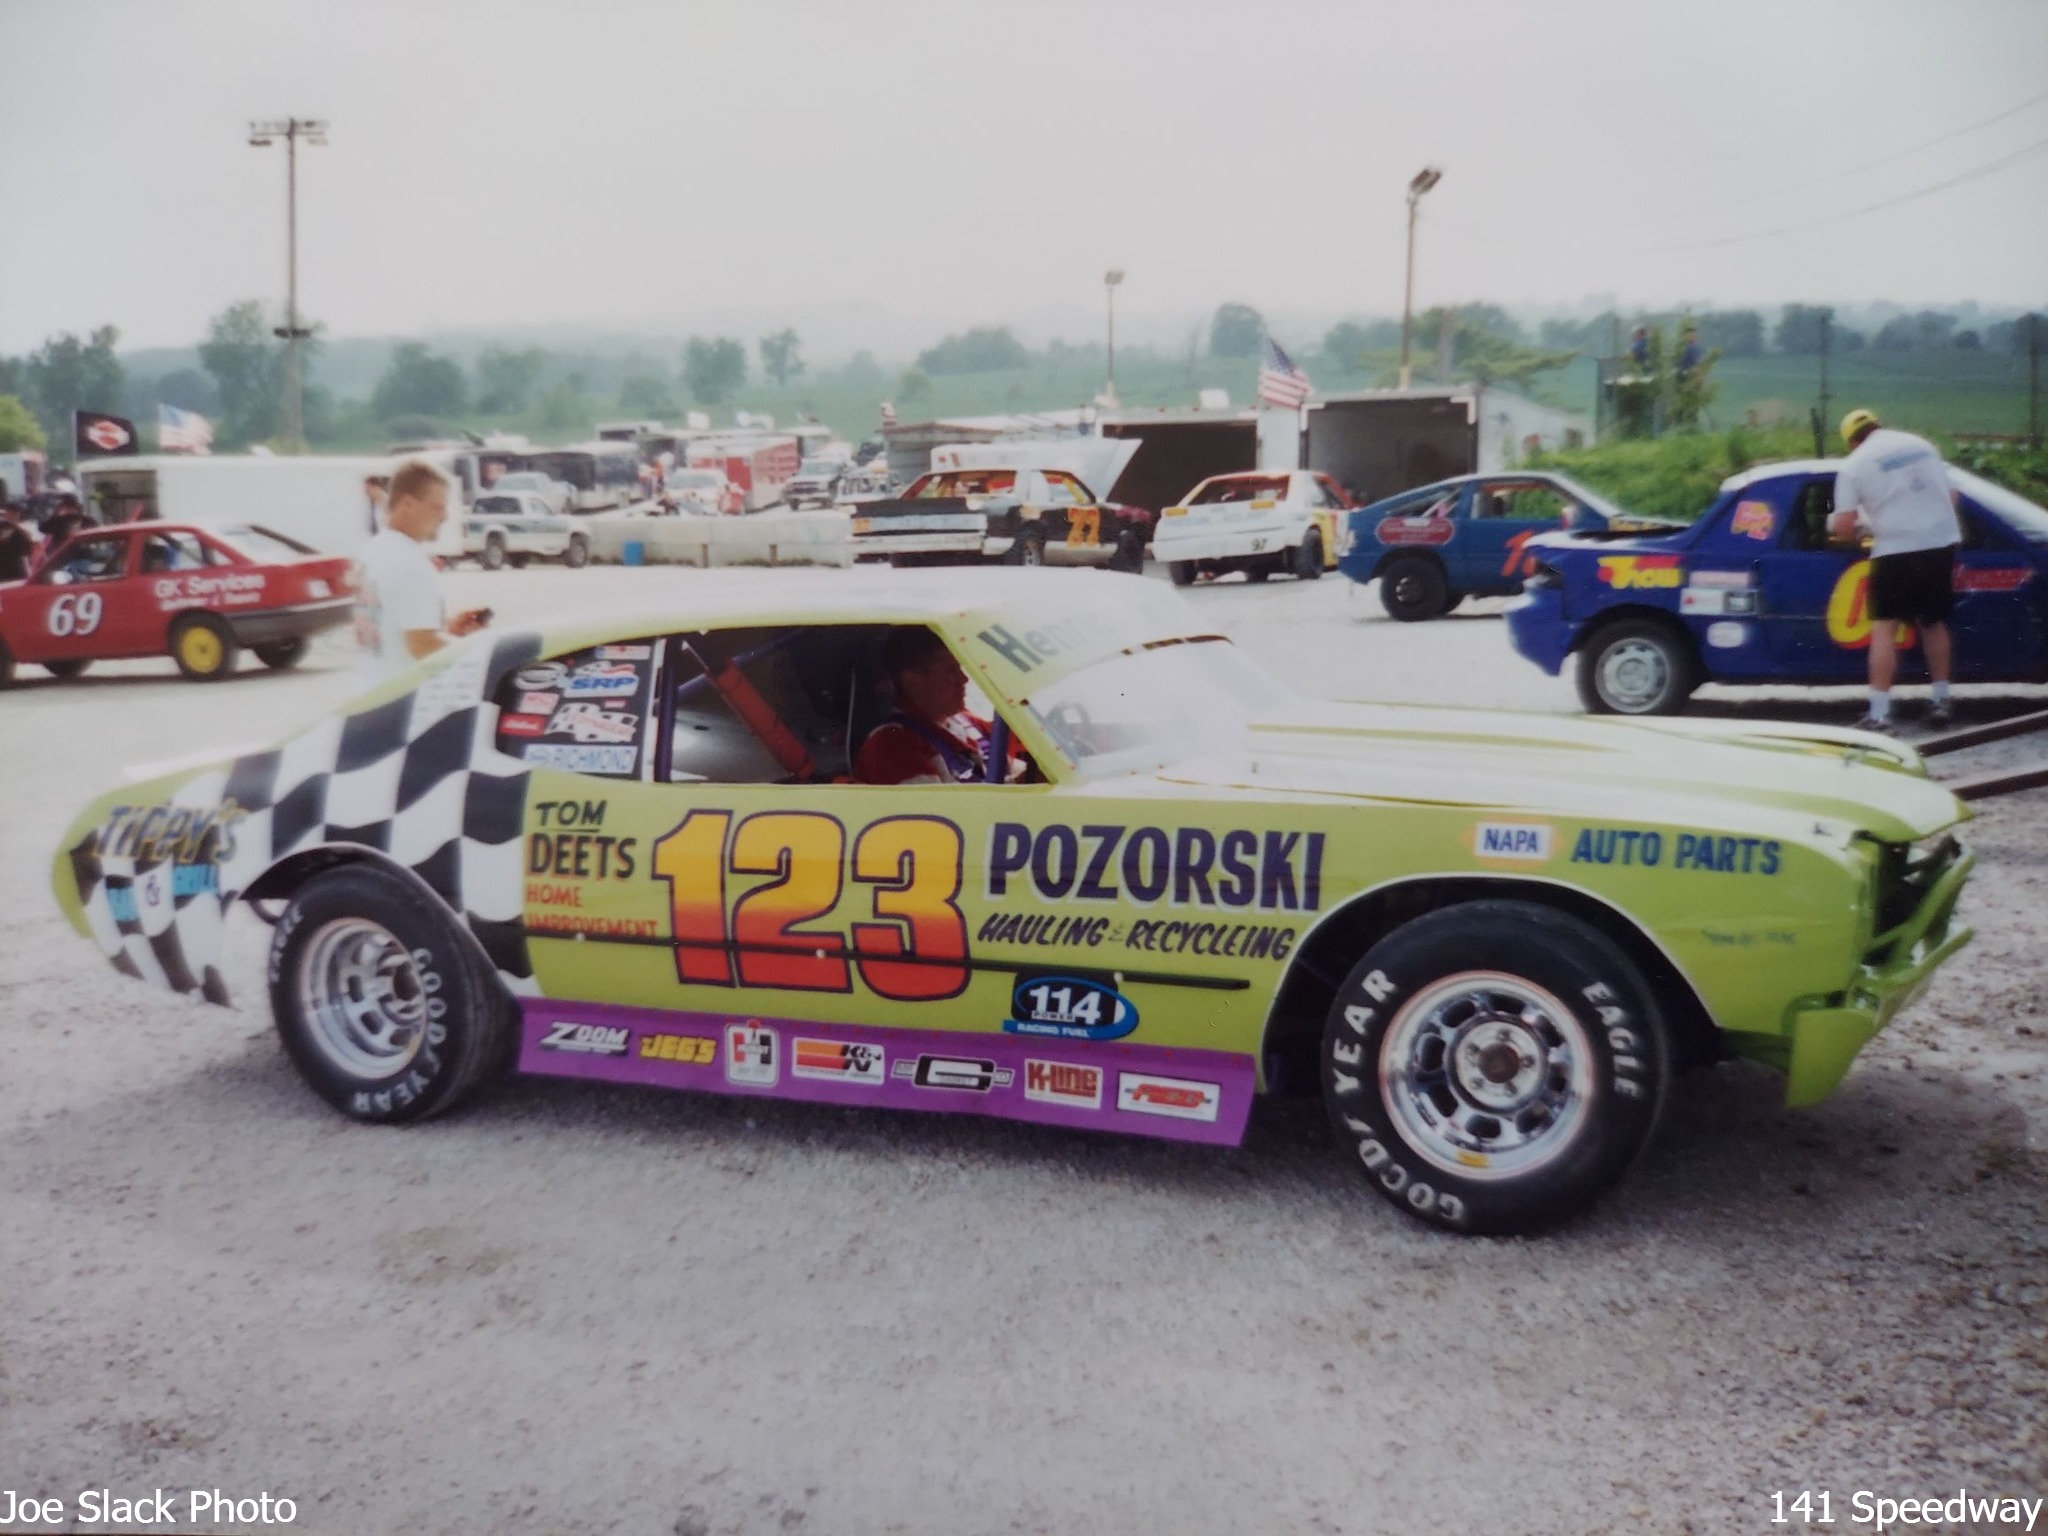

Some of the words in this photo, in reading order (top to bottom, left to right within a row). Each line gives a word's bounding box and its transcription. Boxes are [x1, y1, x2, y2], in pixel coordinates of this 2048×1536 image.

[48, 592, 102, 636] 69
[535, 799, 608, 826] TOM
[525, 832, 638, 882] DEETS
[1484, 828, 1538, 852] NAPA
[1570, 828, 1661, 867] AUTO
[1674, 833, 1781, 876] PARTS
[984, 822, 1325, 912] POZORSKI
[526, 883, 583, 908] HOME
[651, 808, 973, 1001] 123
[526, 913, 658, 938] IMPROVEMENT
[977, 913, 1110, 947] HAULING
[1125, 918, 1297, 961] RECYCLEING
[1029, 985, 1102, 1025] 114
[541, 1020, 630, 1052] ZOOM
[1016, 1022, 1060, 1036] RACING
[1061, 1026, 1091, 1038] FUEL
